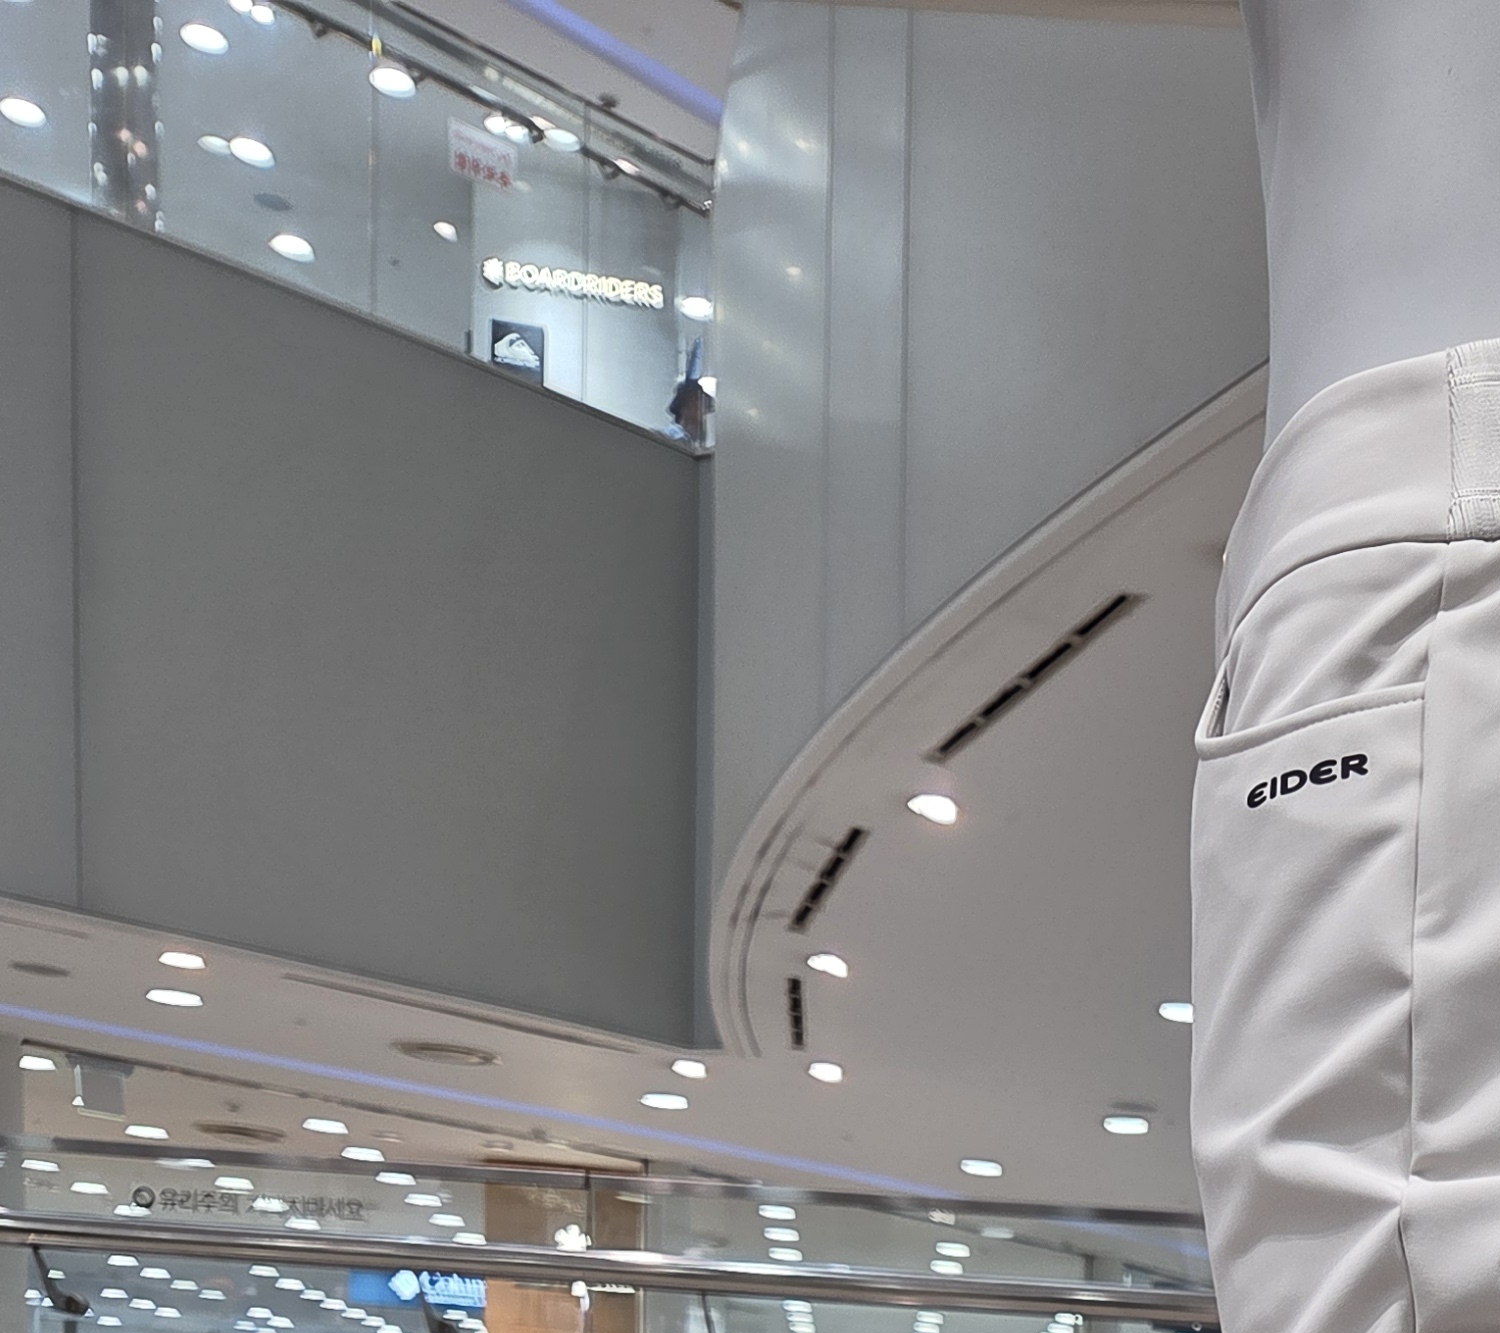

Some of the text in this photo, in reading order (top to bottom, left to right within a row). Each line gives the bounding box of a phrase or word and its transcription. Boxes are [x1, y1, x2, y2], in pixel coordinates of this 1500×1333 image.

[505, 261, 664, 308] BOARDRIDERS
[1247, 754, 1368, 808] EIDER
[246, 1193, 366, 1222] 지마세요
